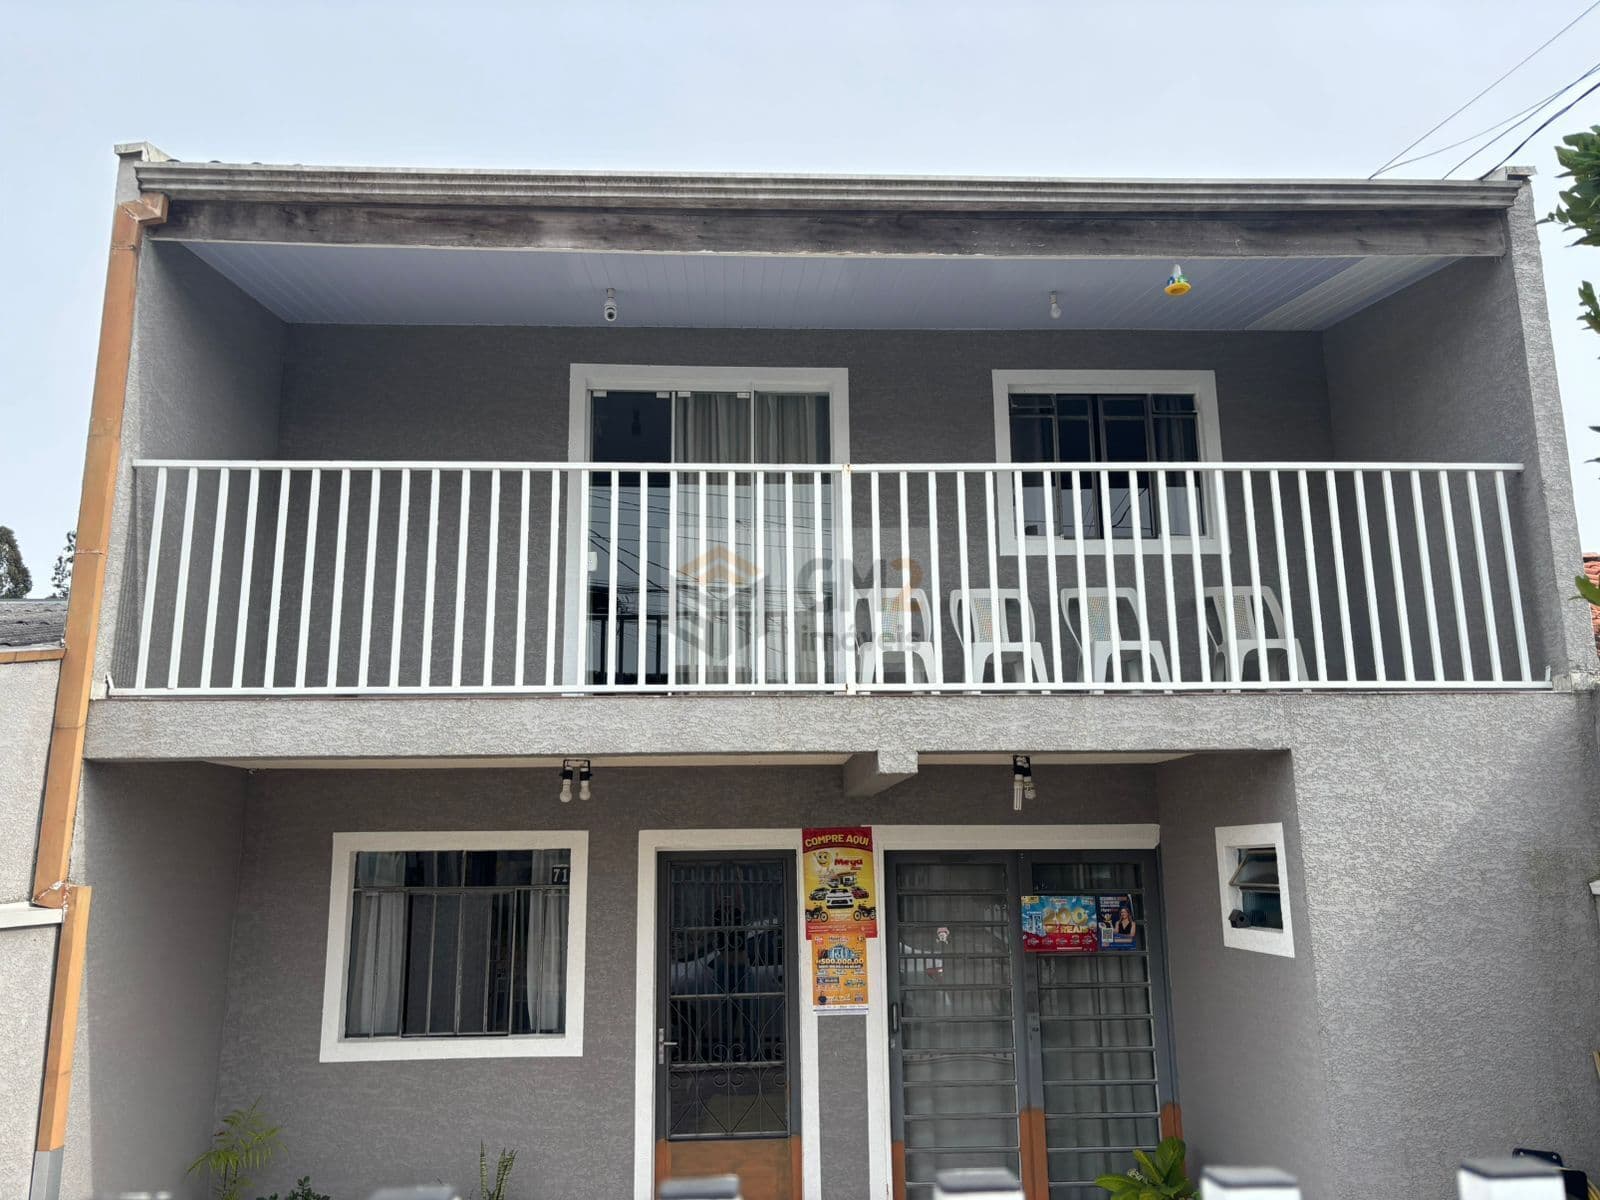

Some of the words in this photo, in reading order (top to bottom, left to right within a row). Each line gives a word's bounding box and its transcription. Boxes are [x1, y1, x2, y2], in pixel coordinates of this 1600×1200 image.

[805, 834, 844, 847] COMPRE
[846, 834, 869, 846] AQUI
[834, 858, 863, 867] Mega
[553, 868, 568, 882] 71
[1043, 907, 1088, 925] 200
